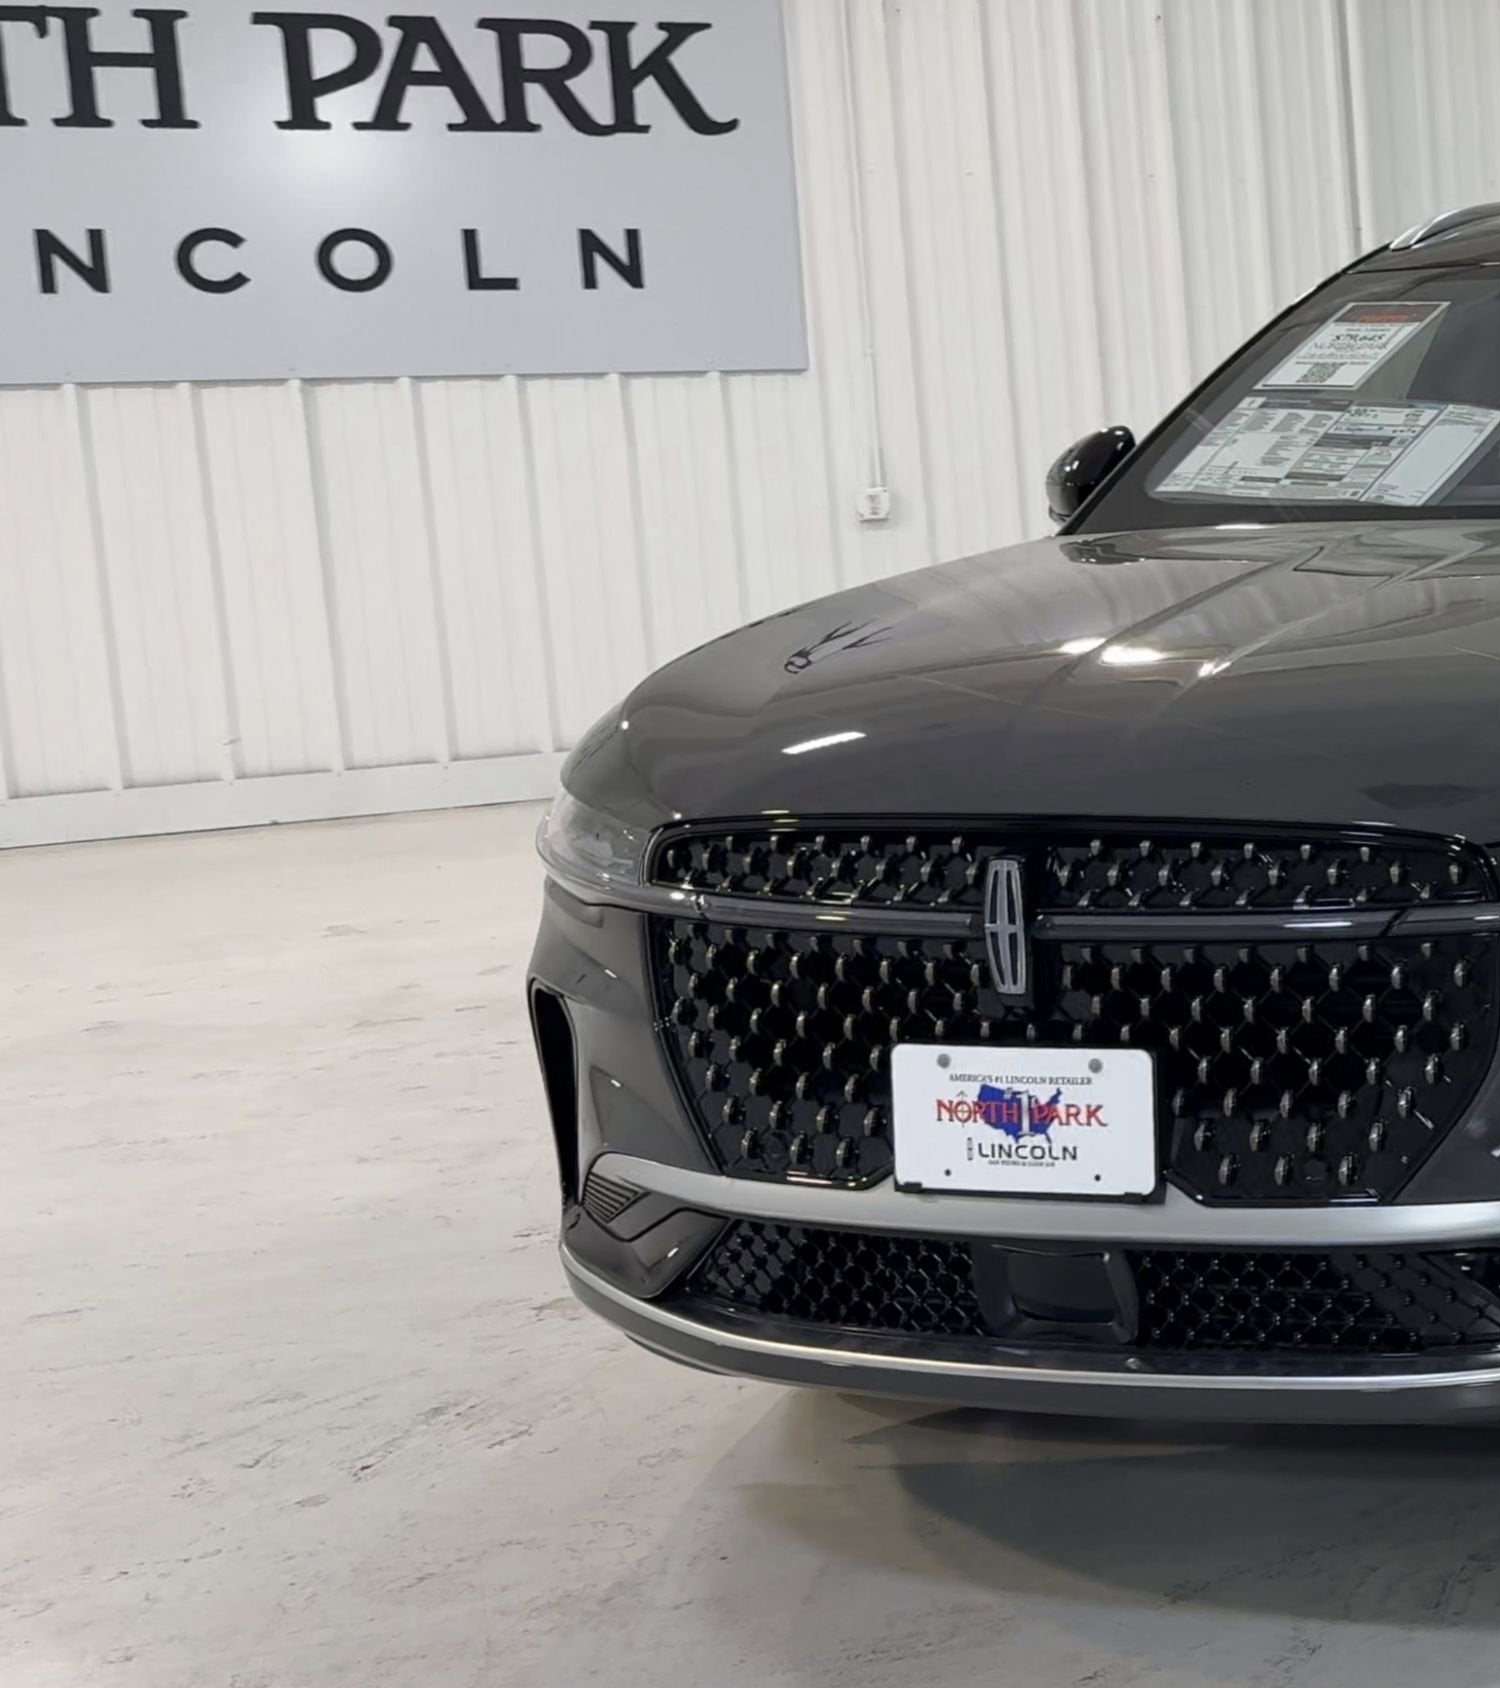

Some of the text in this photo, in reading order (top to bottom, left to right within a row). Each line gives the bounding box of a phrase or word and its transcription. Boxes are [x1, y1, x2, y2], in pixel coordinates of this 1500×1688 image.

[250, 11, 741, 138] PARK
[32, 227, 647, 295] NCOLN
[949, 1073, 993, 1083] AMERICA'S
[1005, 1075, 1047, 1085] LINCOLN
[1048, 1076, 1093, 1086] RETAILER
[936, 1099, 1108, 1127] NORTH PARK
[978, 1142, 1078, 1162] LINCOLN
